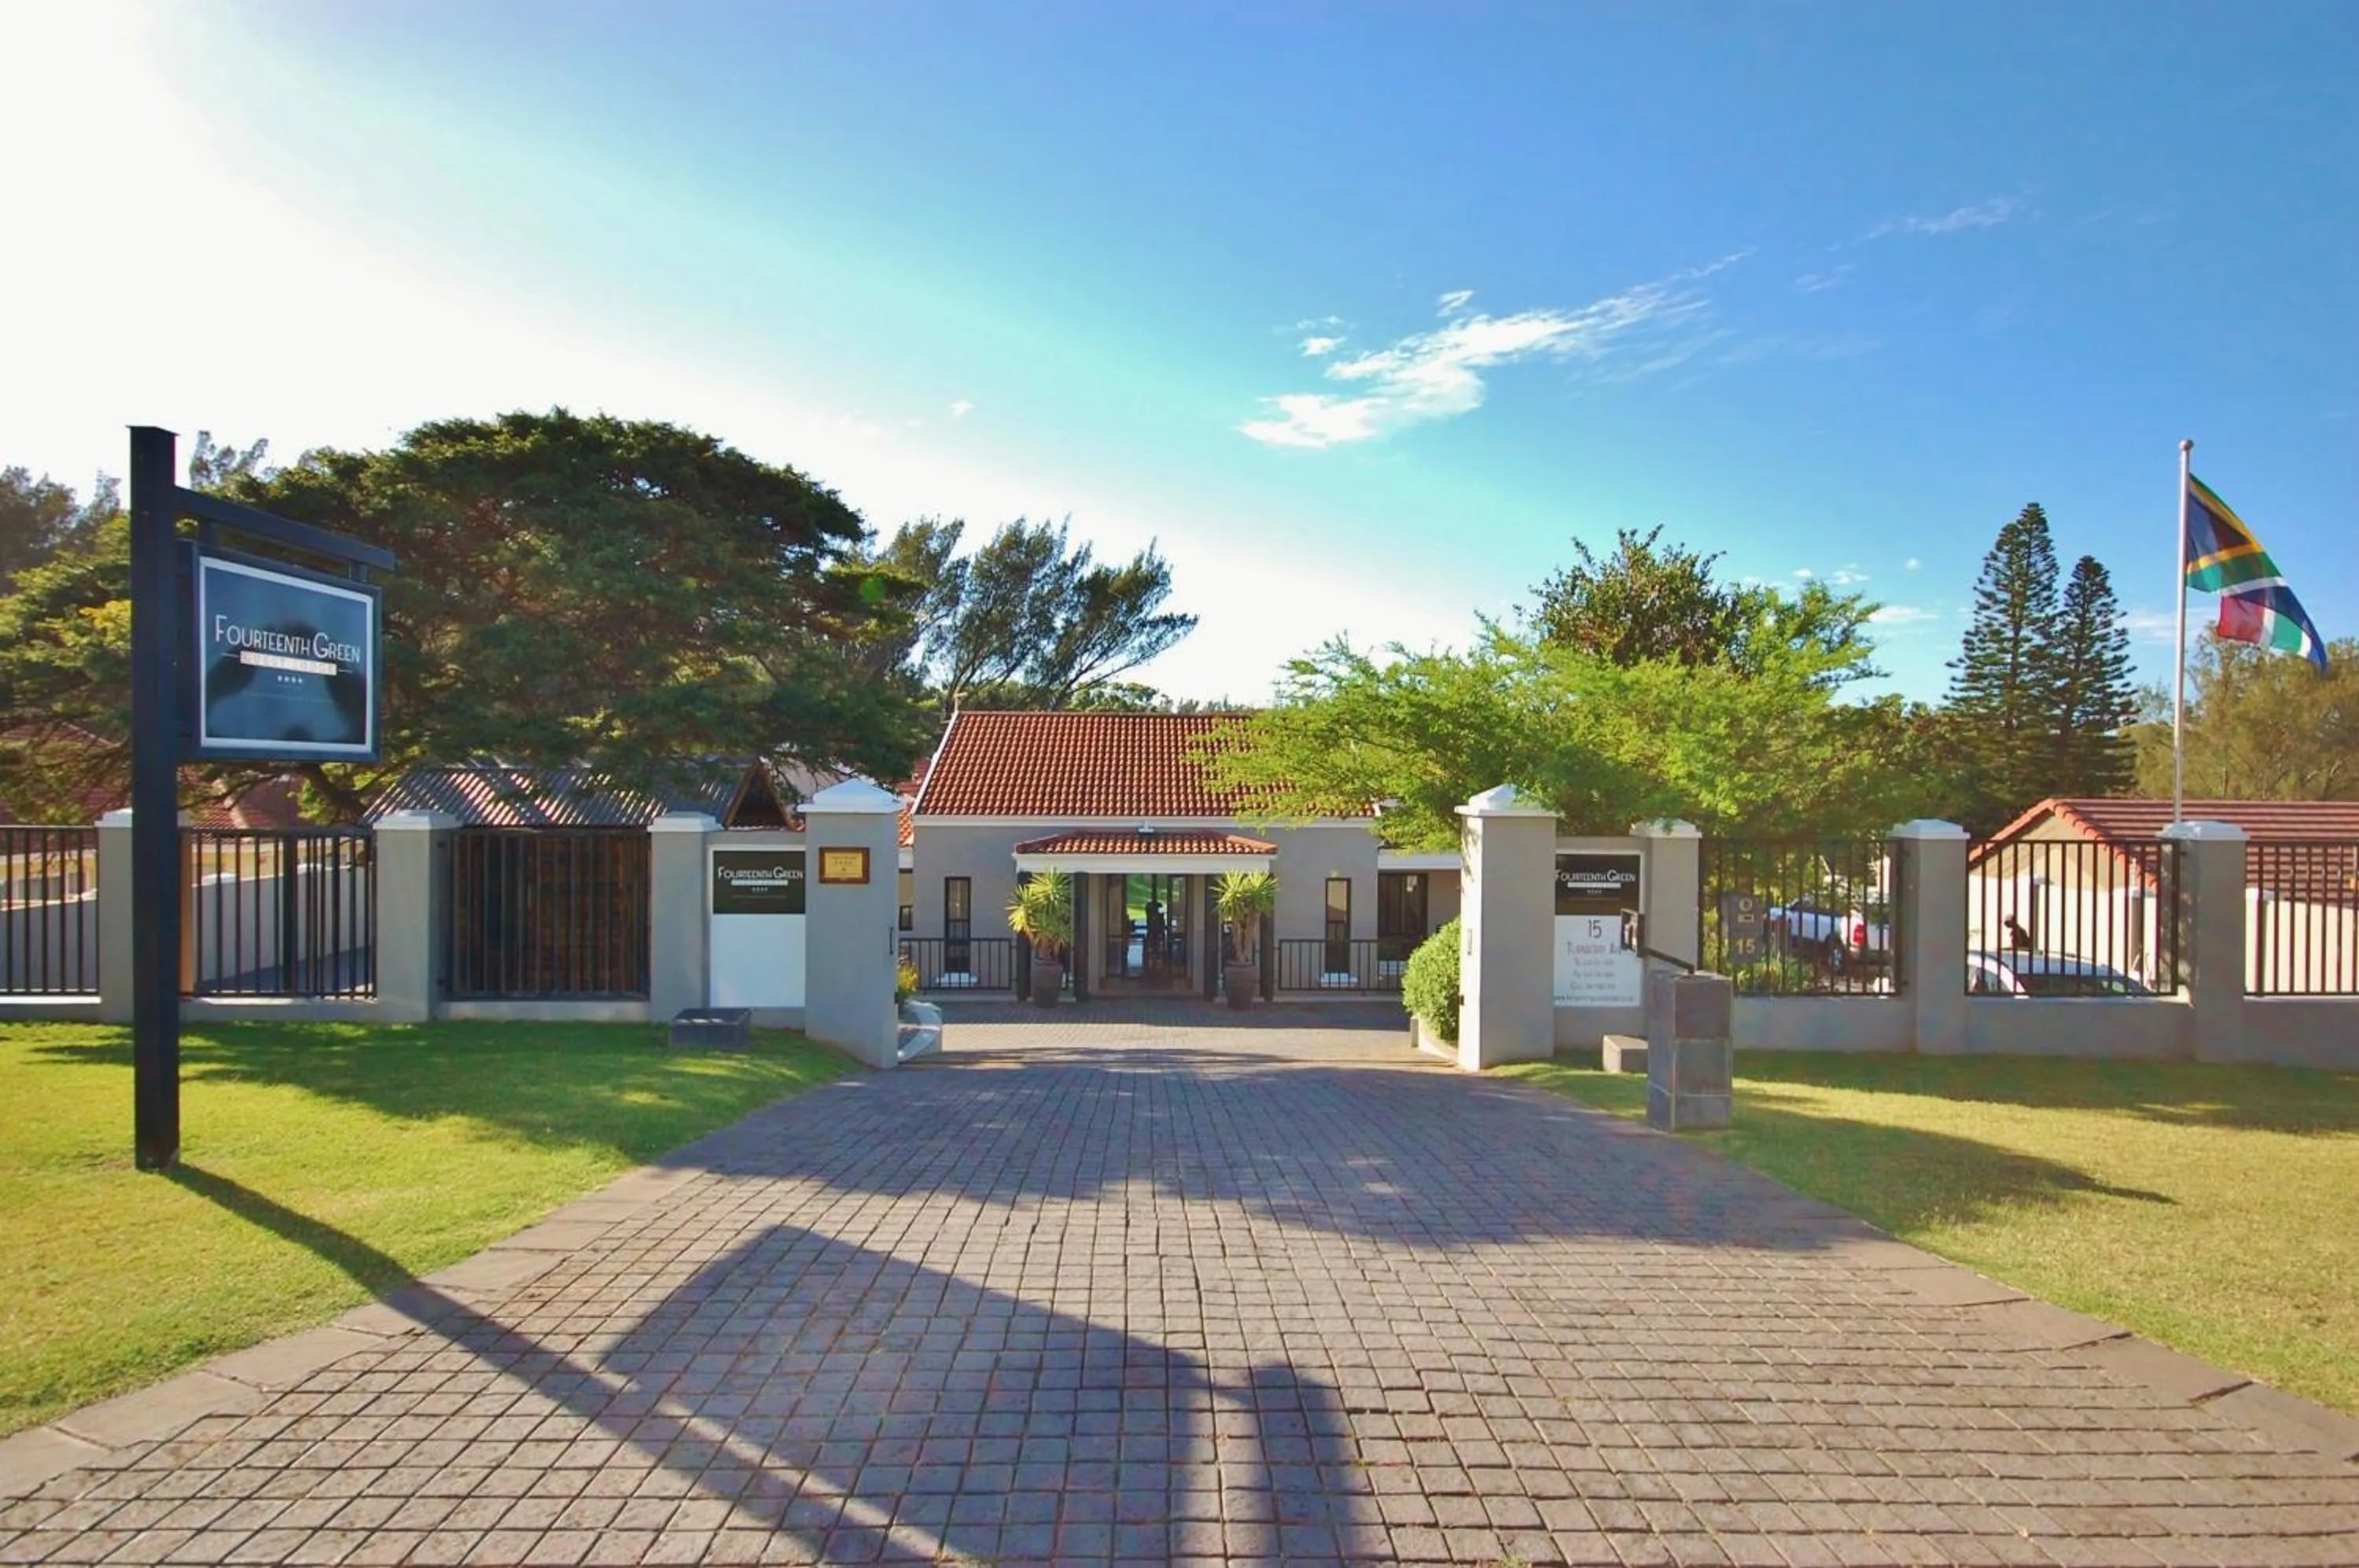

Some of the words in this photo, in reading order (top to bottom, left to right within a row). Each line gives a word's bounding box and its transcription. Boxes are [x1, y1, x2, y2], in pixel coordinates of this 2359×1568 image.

[215, 614, 311, 656] FOURTEENTH
[313, 632, 361, 664] GREEN
[773, 866, 803, 879] GREEN
[1606, 869, 1636, 882] GREEN
[1588, 918, 1602, 938] 15
[1736, 937, 1755, 955] 15
